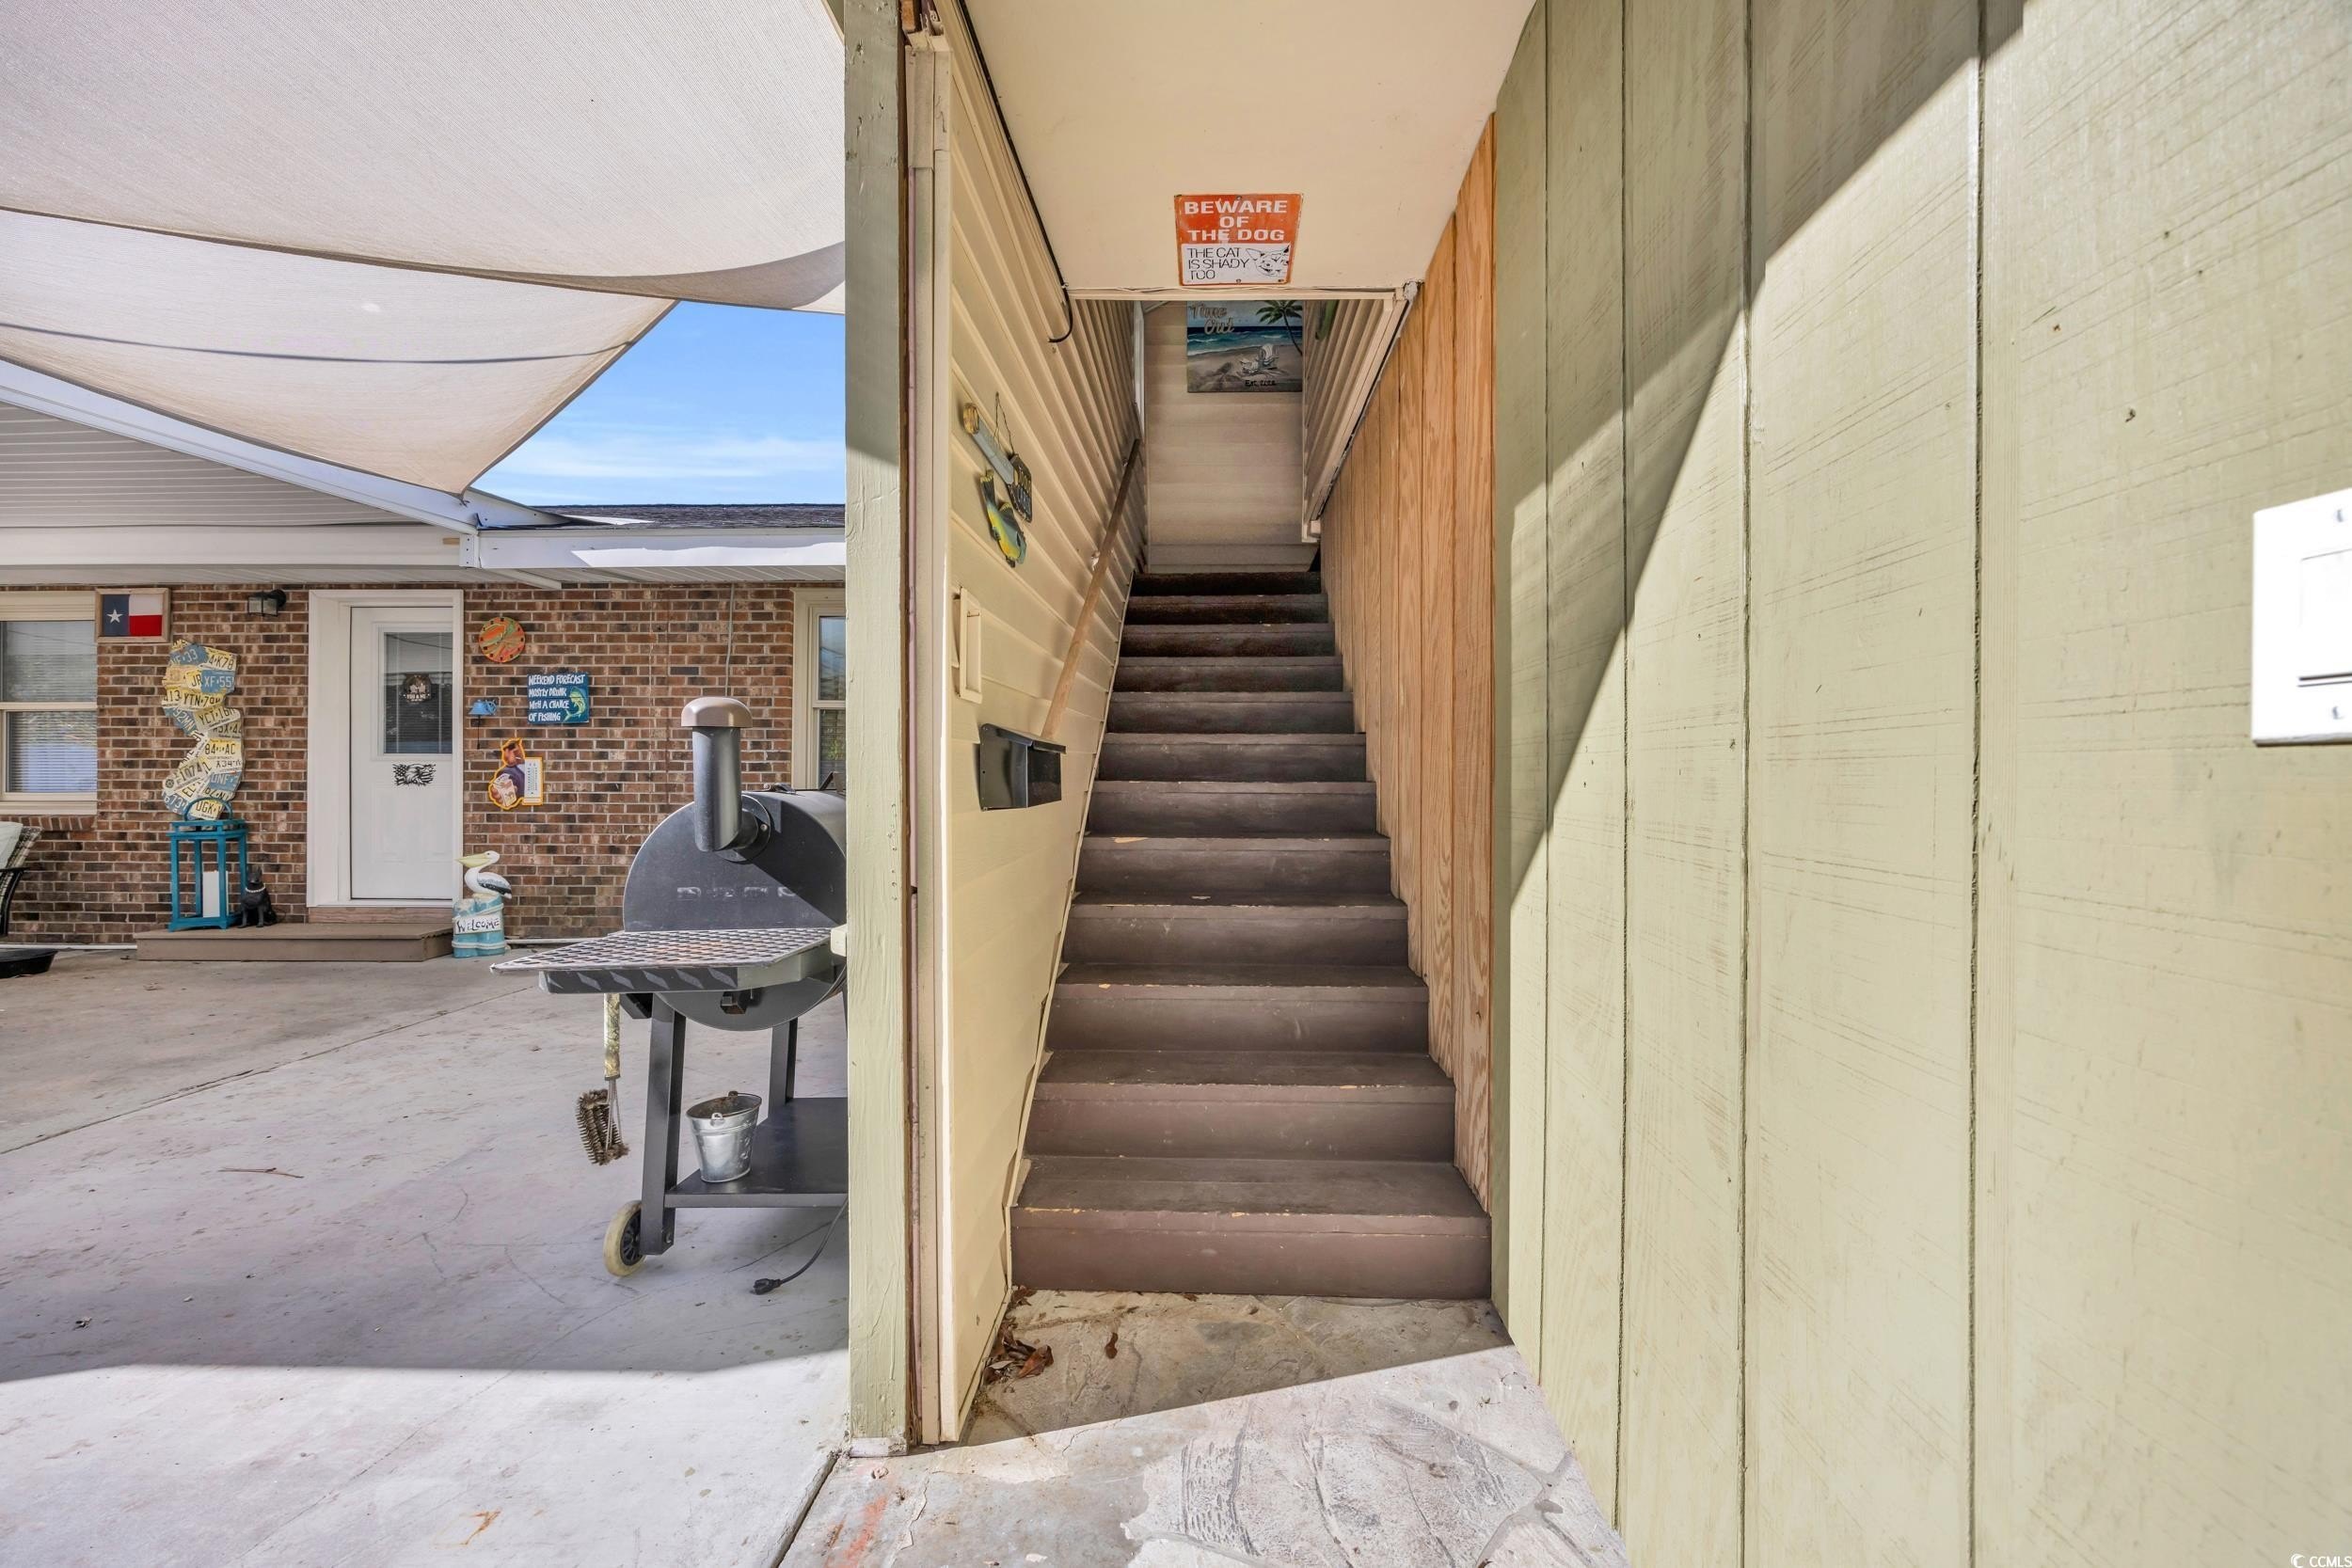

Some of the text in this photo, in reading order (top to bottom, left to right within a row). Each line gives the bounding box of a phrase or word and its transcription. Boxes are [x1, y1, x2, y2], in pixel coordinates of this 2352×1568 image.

[1184, 200, 1288, 214] BEWARE
[1219, 215, 1250, 229] OF
[1187, 230, 1285, 242] THE DOG
[1187, 246, 1241, 259] THE CAT
[1188, 258, 1250, 270] IS SHADY
[1189, 269, 1216, 280] TOO
[528, 673, 586, 686] WEEKEND FORECAST
[528, 688, 548, 698] MOSTLY
[542, 700, 548, 709] A
[548, 699, 570, 709] CHANCE
[528, 712, 562, 721] OF FISHING
[456, 919, 500, 932] WELCOME
